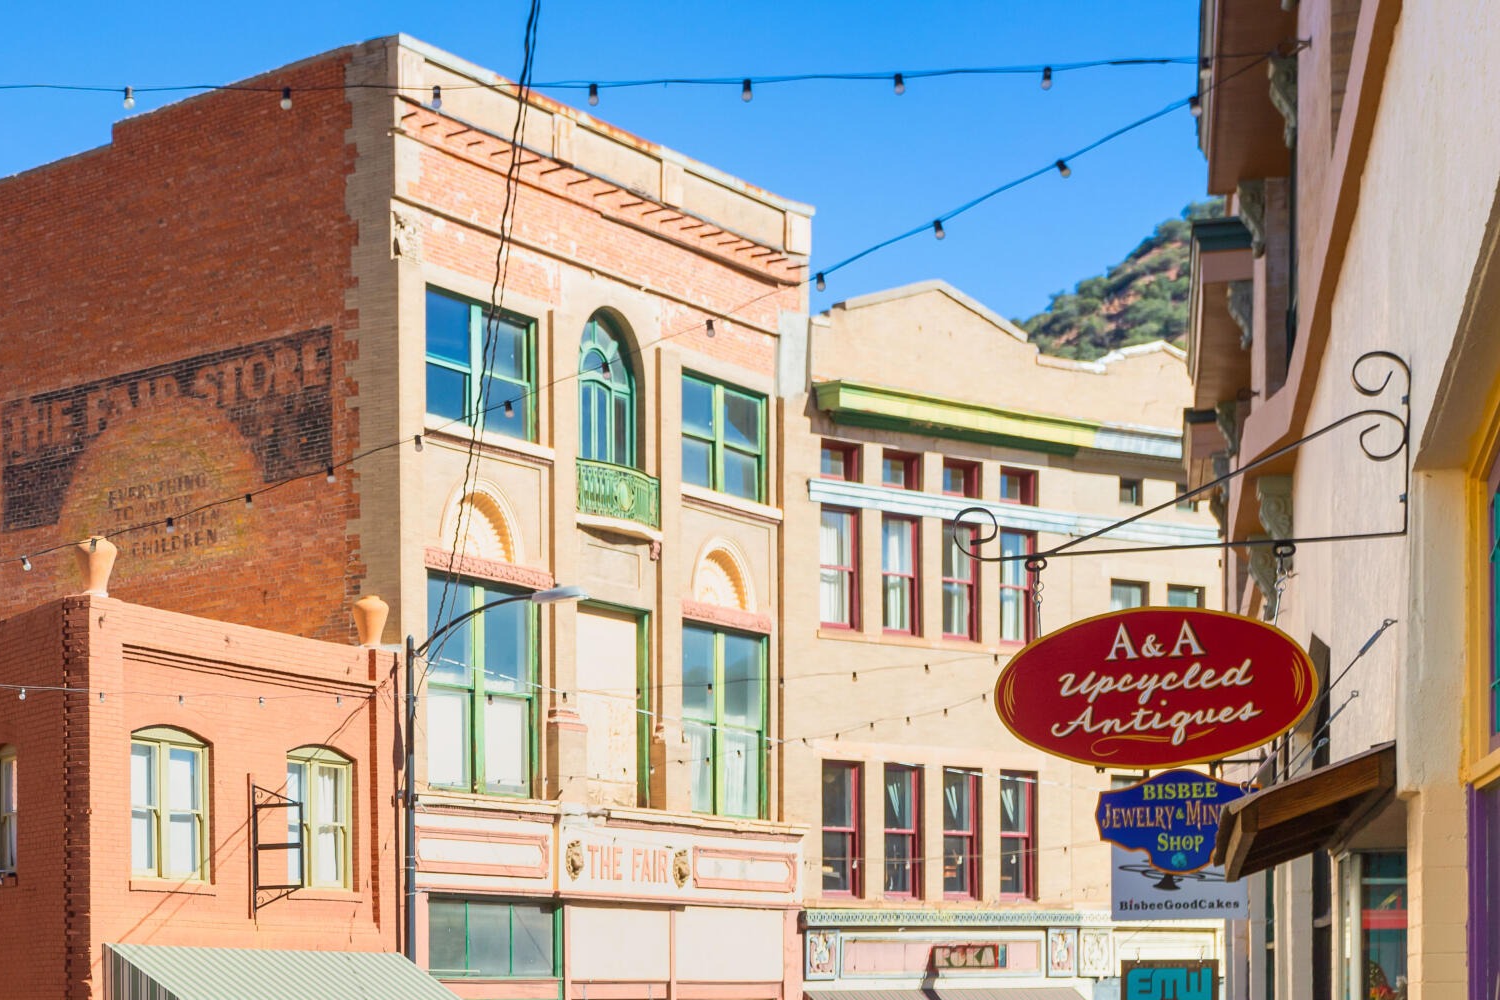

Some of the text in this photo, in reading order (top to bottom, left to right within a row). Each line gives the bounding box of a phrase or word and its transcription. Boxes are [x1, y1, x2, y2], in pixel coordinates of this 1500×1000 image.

[191, 341, 329, 407] STORE
[108, 472, 207, 508] EVERYTHING
[131, 529, 217, 556] CHILDREN
[1105, 619, 1207, 661] A & A
[1058, 658, 1255, 704] Upcycled
[1051, 700, 1263, 746] Antiques
[1143, 781, 1219, 801] BISBEE
[1175, 807, 1185, 820] &
[587, 844, 668, 884] THE FAIR
[1119, 898, 1240, 911] BisbeeGoodCakes
[935, 944, 996, 967] ROKA
